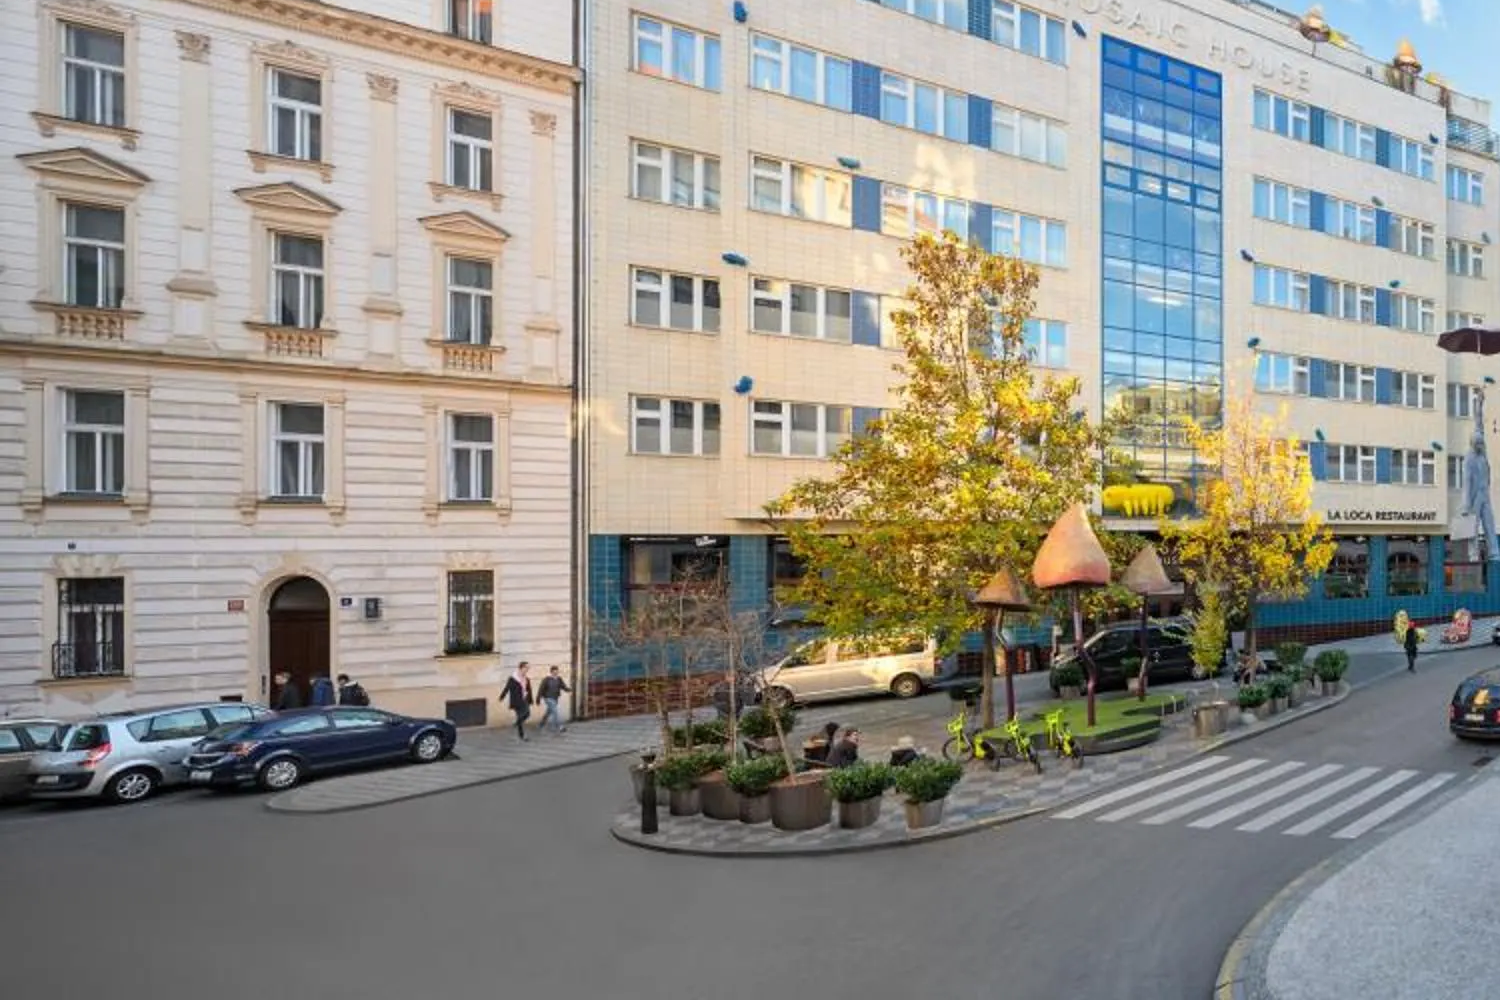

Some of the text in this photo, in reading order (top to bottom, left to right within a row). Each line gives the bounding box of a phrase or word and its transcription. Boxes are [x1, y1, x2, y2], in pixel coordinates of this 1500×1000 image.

[1209, 42, 1311, 93] HOUSE
[1327, 509, 1437, 521] LA LOCA RESTAURANT
